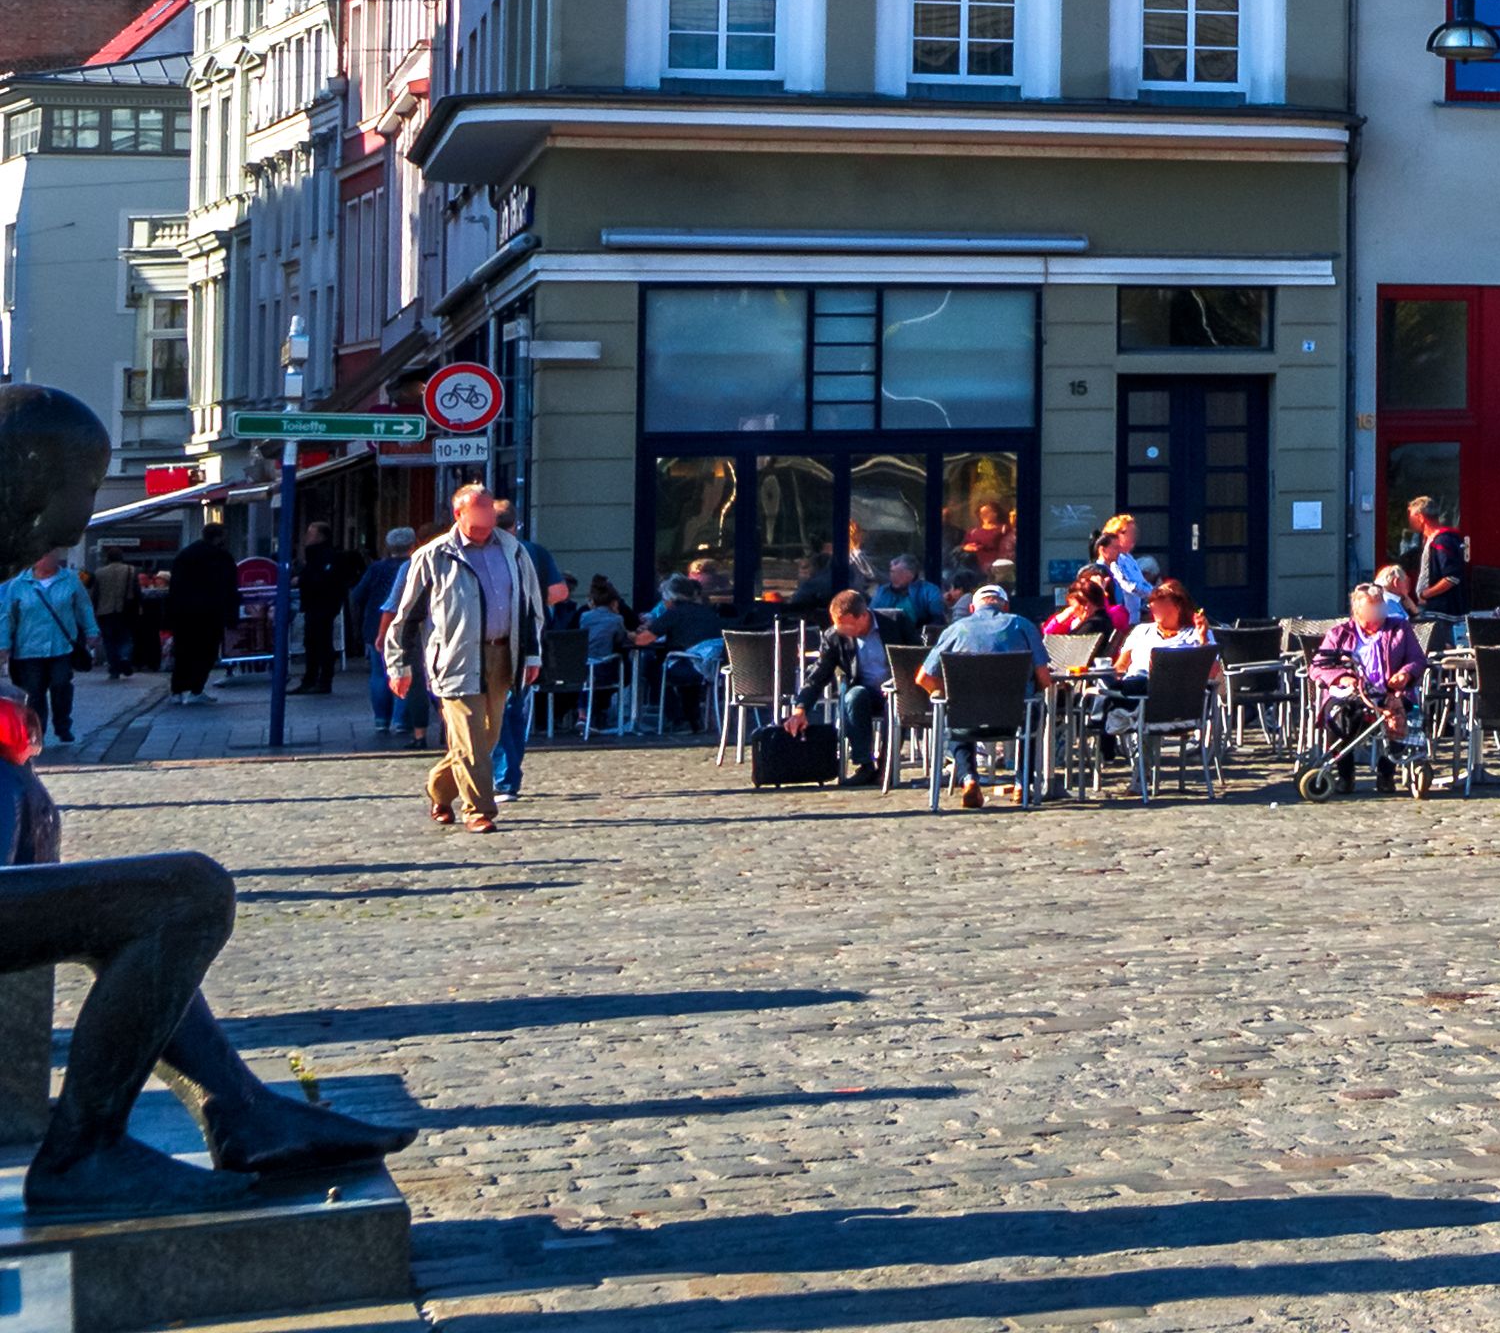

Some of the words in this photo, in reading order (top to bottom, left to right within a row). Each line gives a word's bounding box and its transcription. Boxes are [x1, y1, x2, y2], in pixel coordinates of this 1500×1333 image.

[1069, 380, 1088, 396] 15
[281, 419, 327, 432] Toilette
[1356, 413, 1376, 431] 16
[438, 443, 471, 457] 10-19
